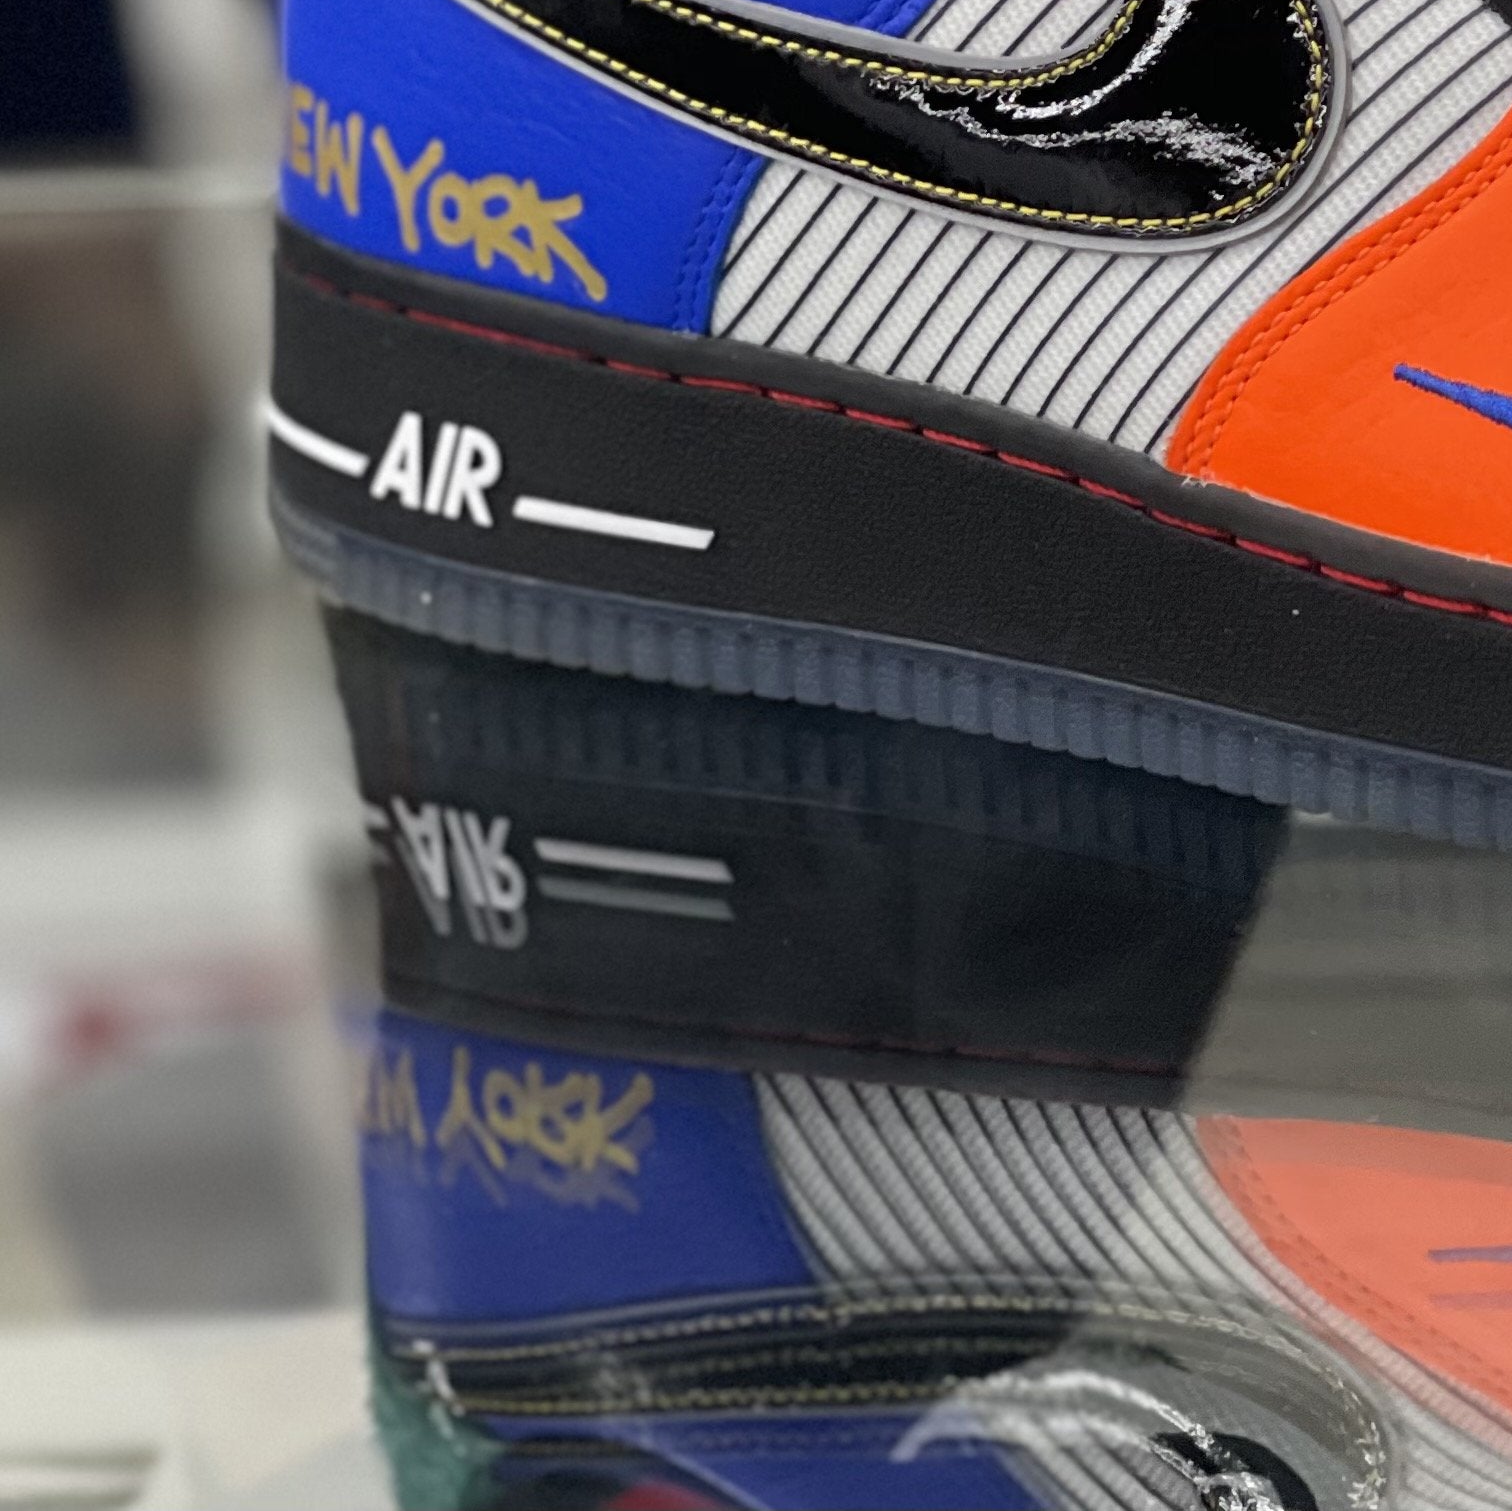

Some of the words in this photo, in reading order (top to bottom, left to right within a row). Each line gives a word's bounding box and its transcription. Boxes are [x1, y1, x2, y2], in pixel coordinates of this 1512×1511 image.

[286, 82, 364, 218] EW
[372, 126, 608, 303] YORK
[369, 410, 502, 529] AIR
